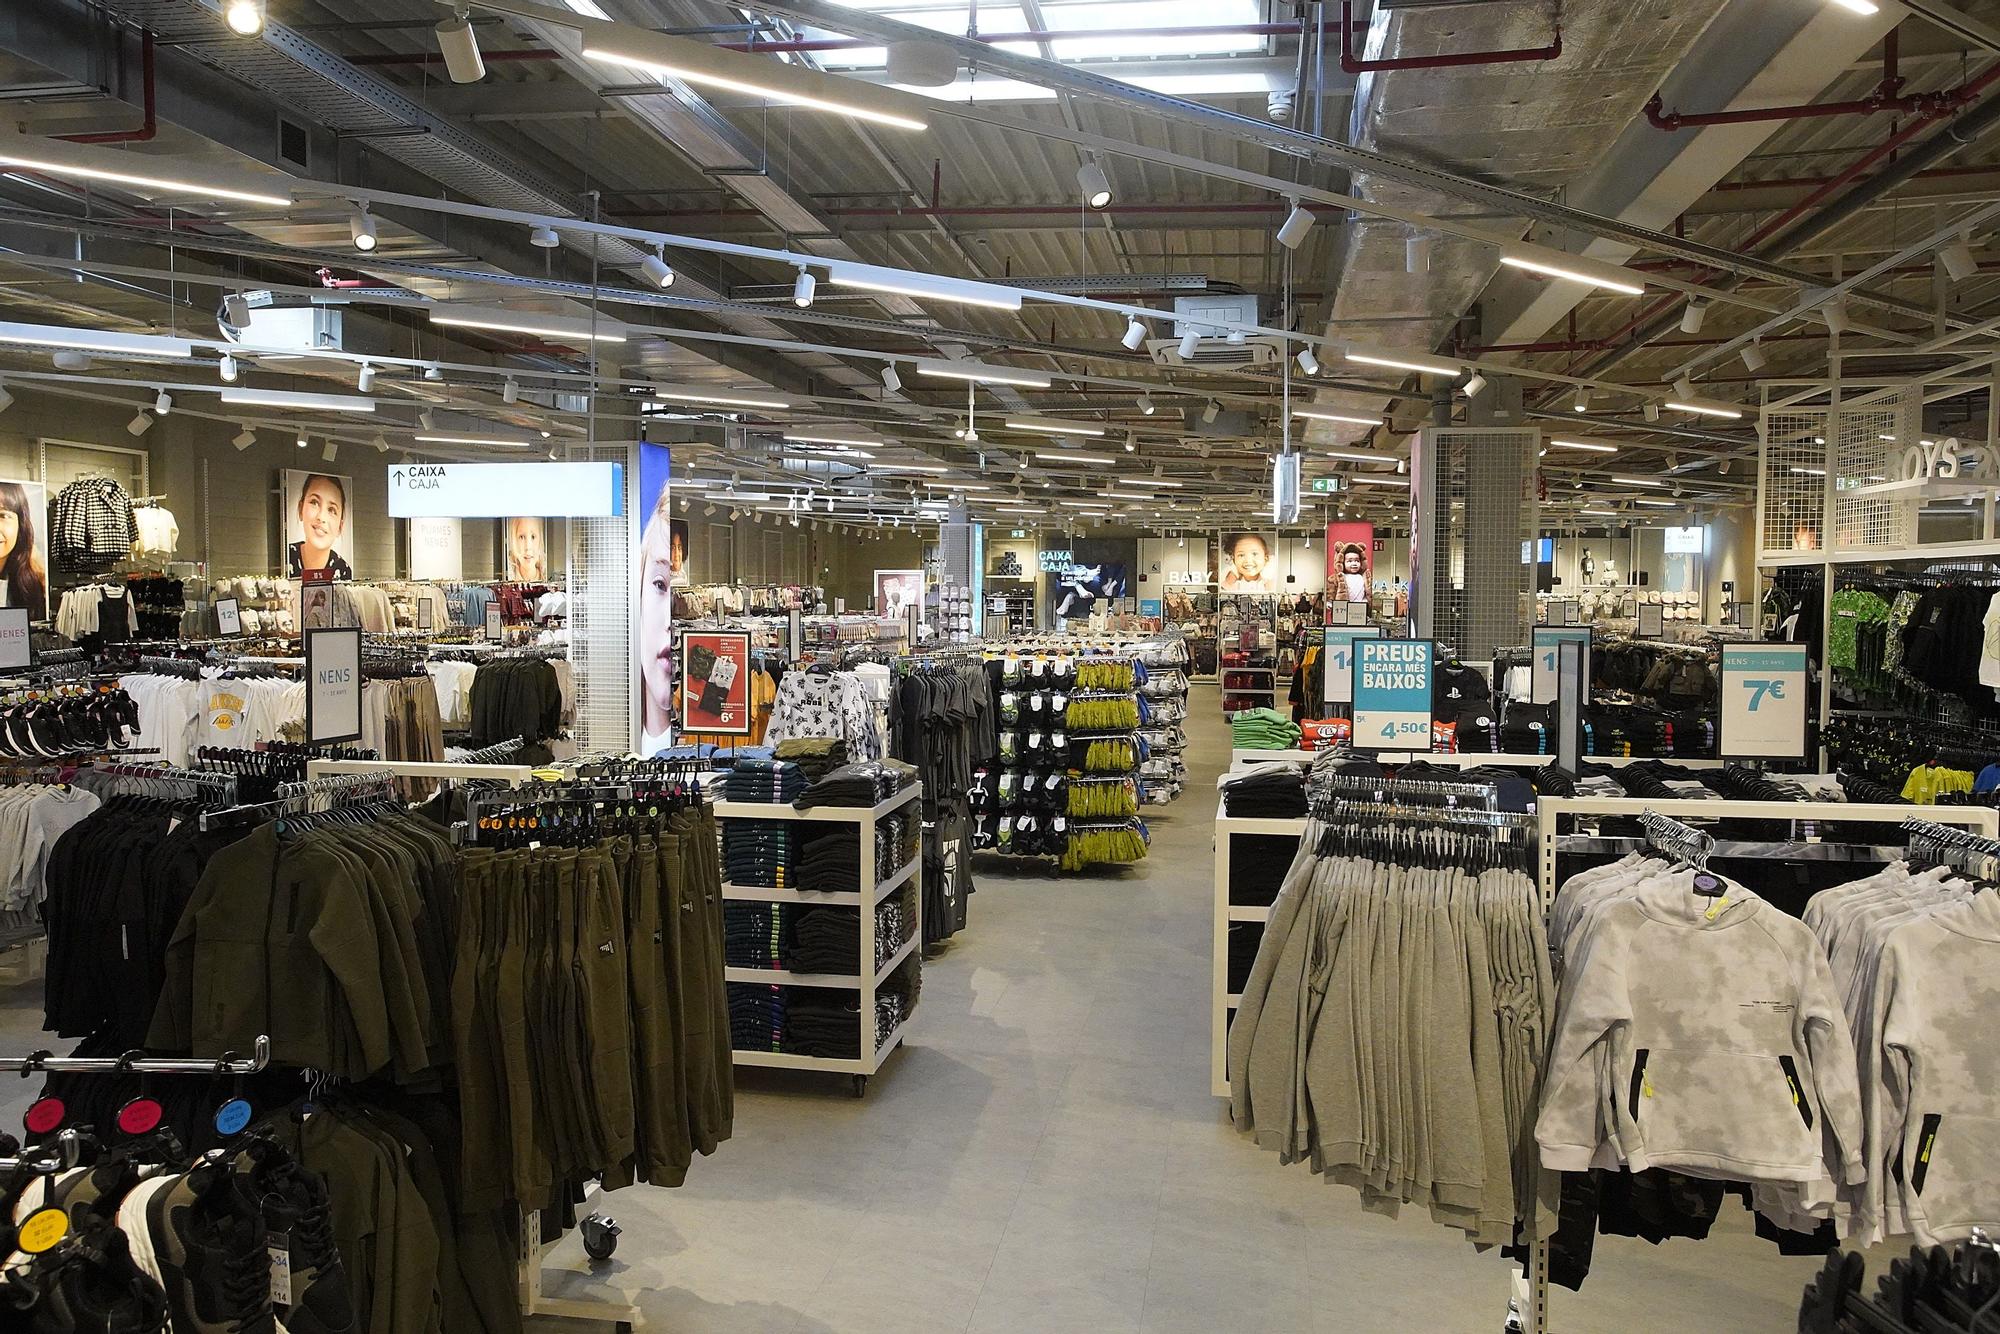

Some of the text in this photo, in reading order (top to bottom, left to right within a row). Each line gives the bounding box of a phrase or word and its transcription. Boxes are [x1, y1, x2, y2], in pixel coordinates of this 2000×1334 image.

[408, 466, 446, 477] CAIXA
[408, 478, 440, 489] CAJA
[1039, 551, 1072, 561] CAIXA
[1040, 561, 1070, 571] CAJA
[1169, 571, 1213, 584] BABY
[1363, 644, 1427, 662] PREUS
[1363, 660, 1426, 673] ENCARA MÉS
[319, 668, 351, 685] NENS
[1362, 673, 1426, 690] BAIXOS
[1743, 680, 1785, 711] 7€
[720, 712, 734, 723] 6€
[1381, 721, 1428, 740] 4.50€
